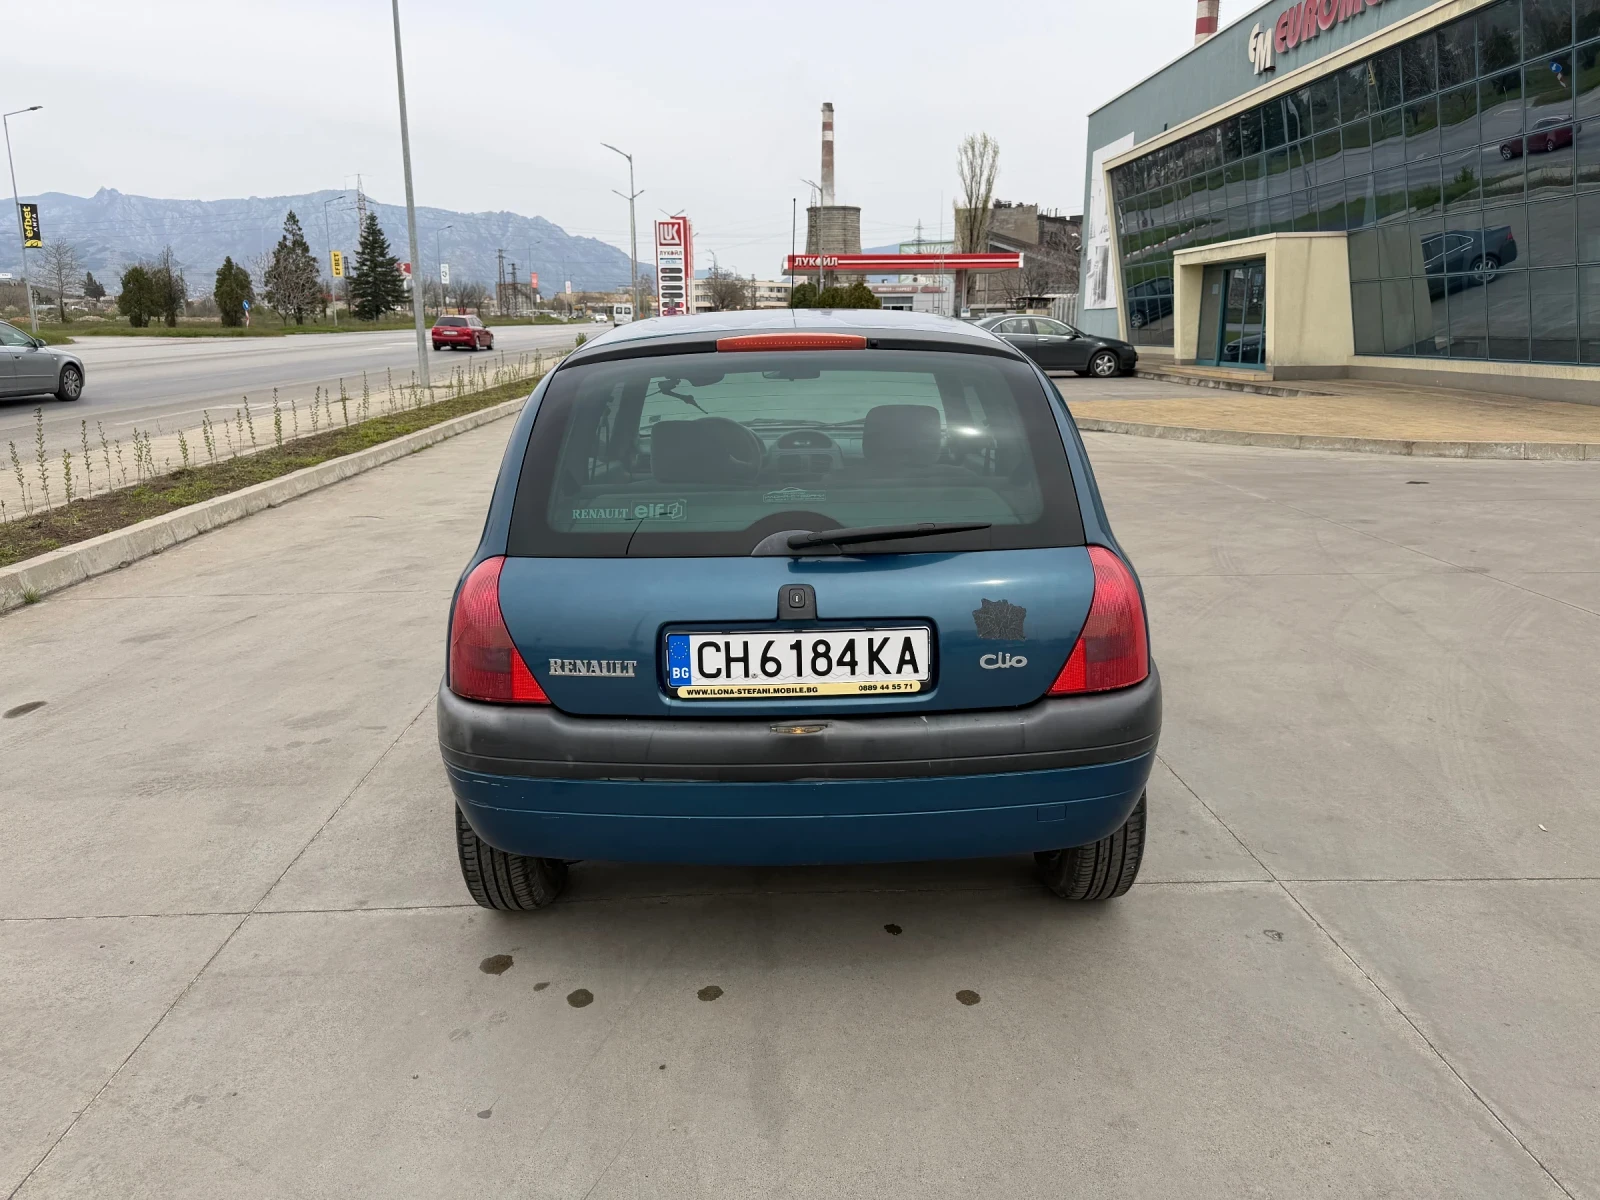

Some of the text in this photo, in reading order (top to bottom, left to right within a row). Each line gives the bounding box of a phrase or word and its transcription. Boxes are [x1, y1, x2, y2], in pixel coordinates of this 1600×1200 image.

[1275, 0, 1382, 53] EUROM
[23, 206, 33, 237] efbet
[572, 503, 664, 519] RENAULT elf
[548, 658, 637, 677] RENAULT
[979, 651, 1028, 669] Clio
[672, 667, 690, 679] BG
[686, 686, 818, 697] WWW.ILONA-STEFANI.MOBILE.BG
